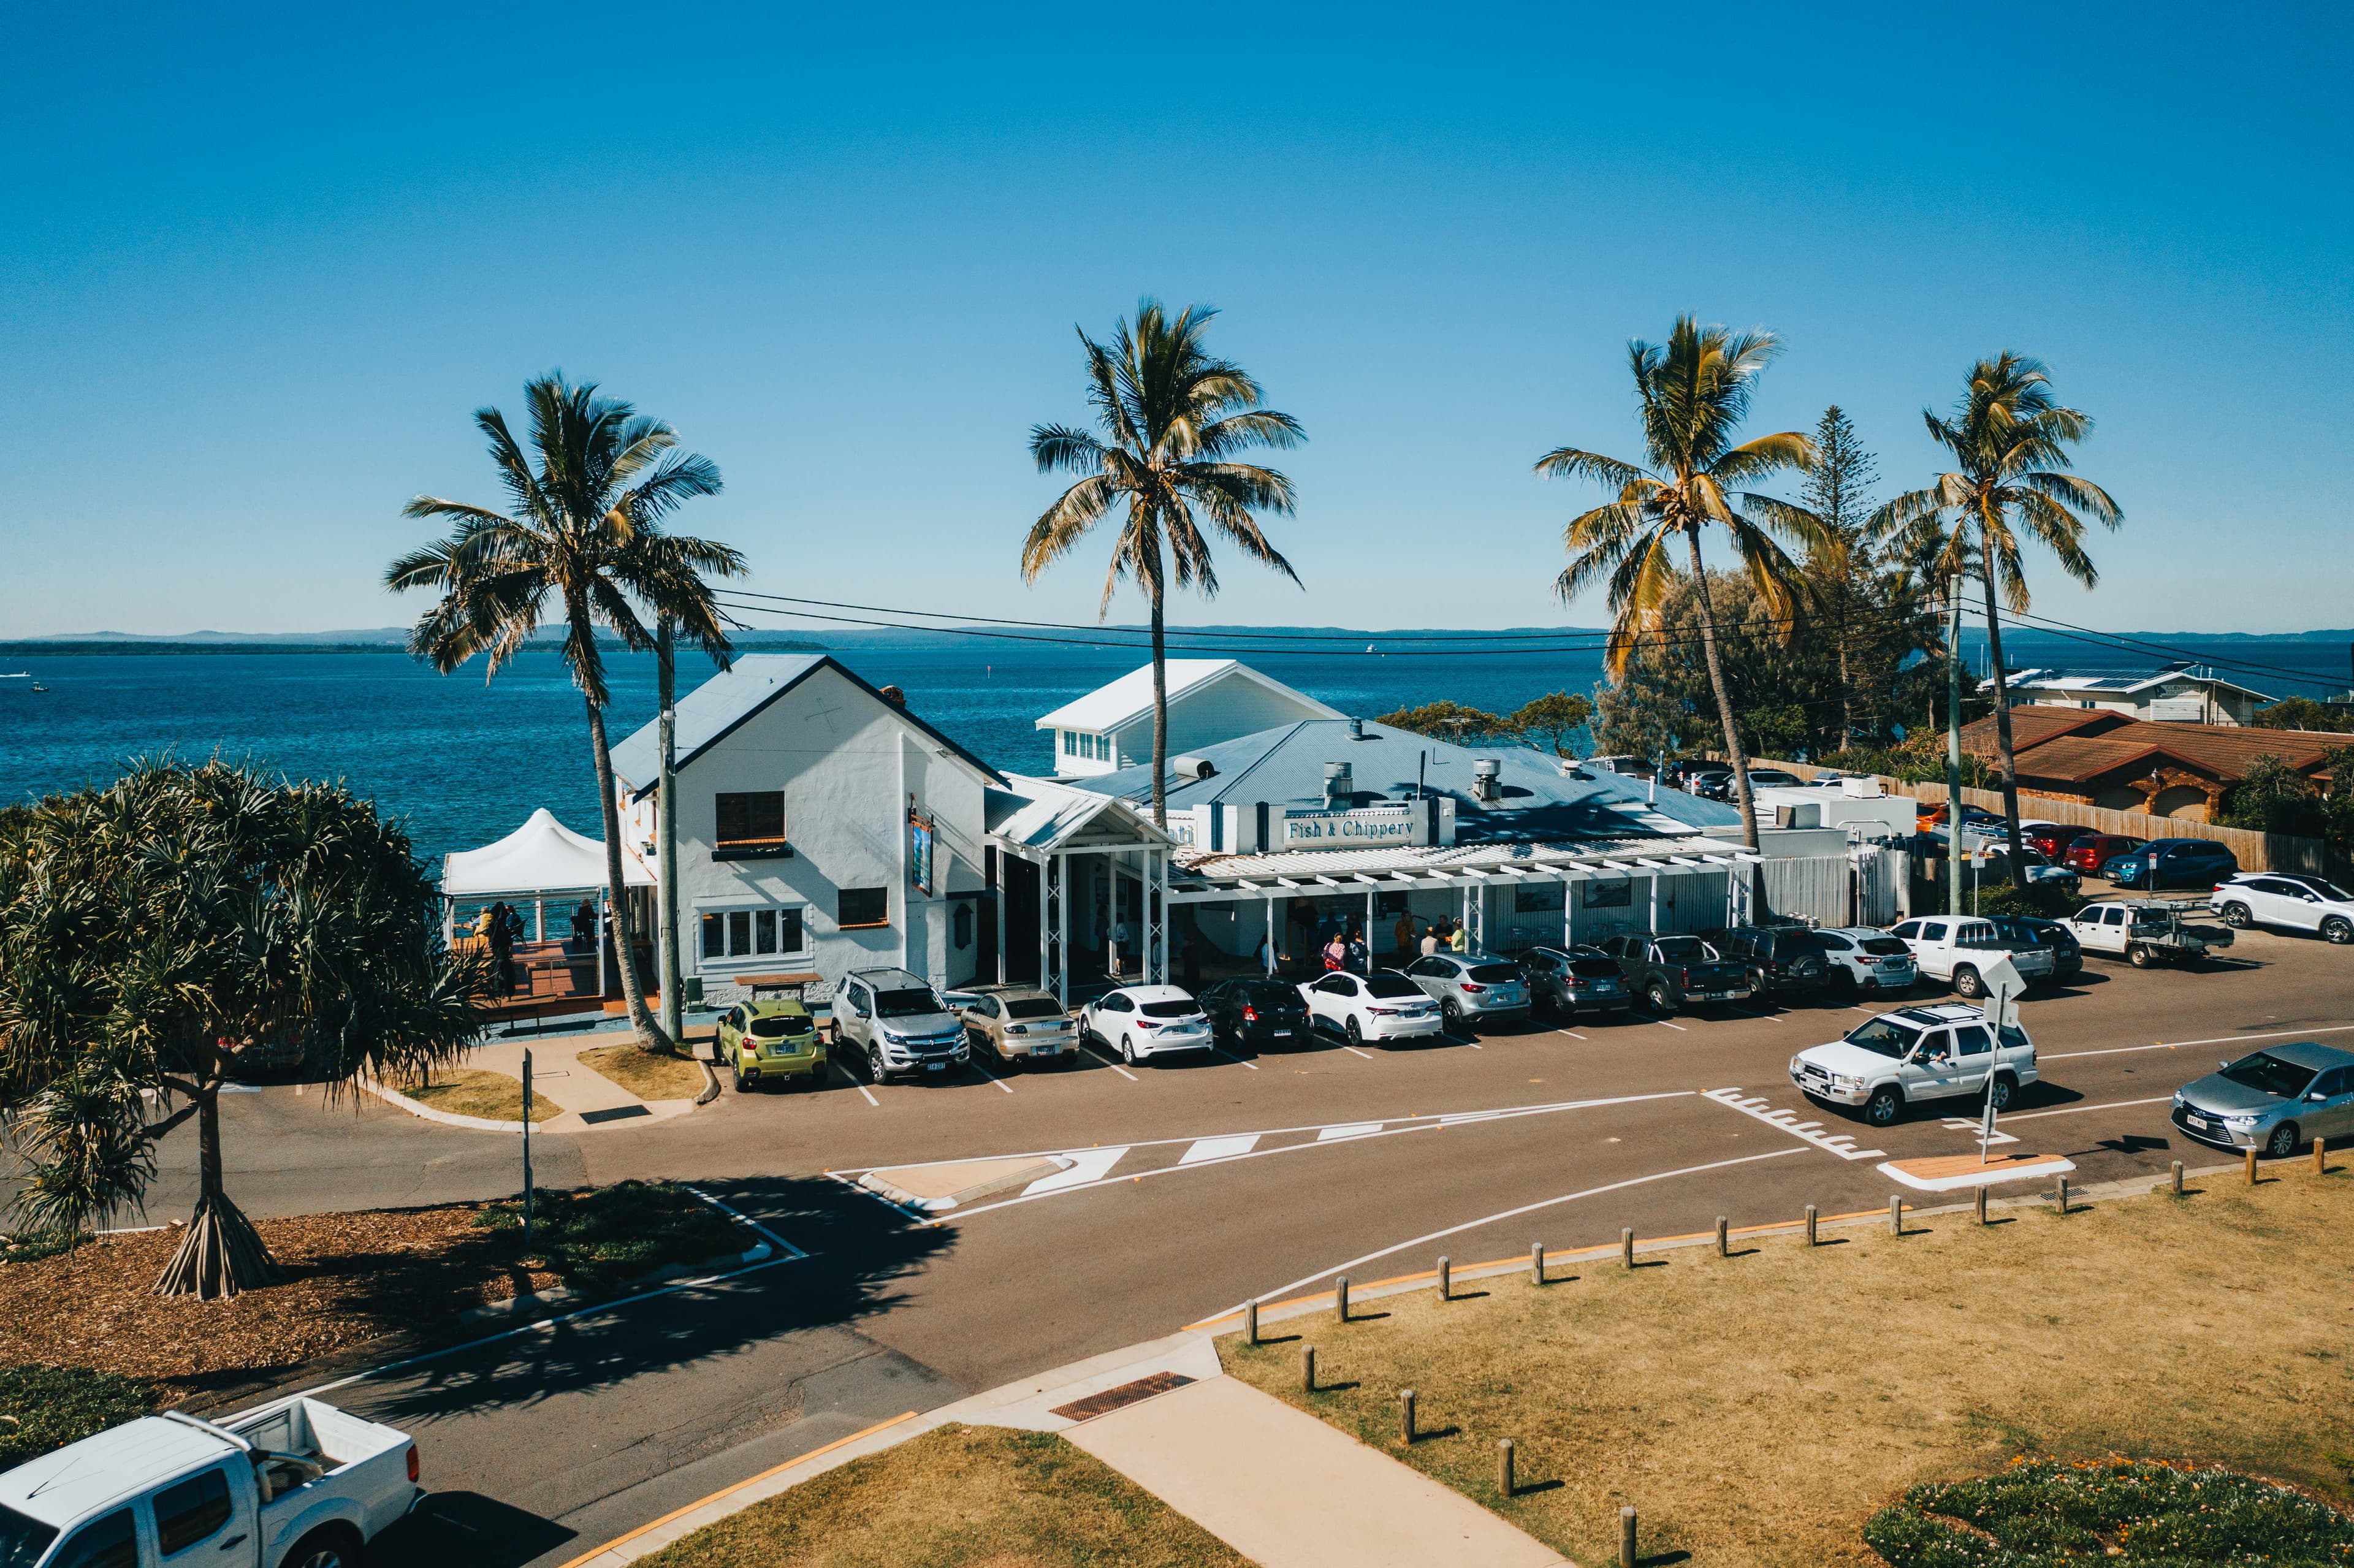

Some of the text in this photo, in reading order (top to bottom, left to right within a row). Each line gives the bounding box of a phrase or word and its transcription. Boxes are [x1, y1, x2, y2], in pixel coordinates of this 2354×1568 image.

[1289, 820, 1414, 840] Fish & Chippery
